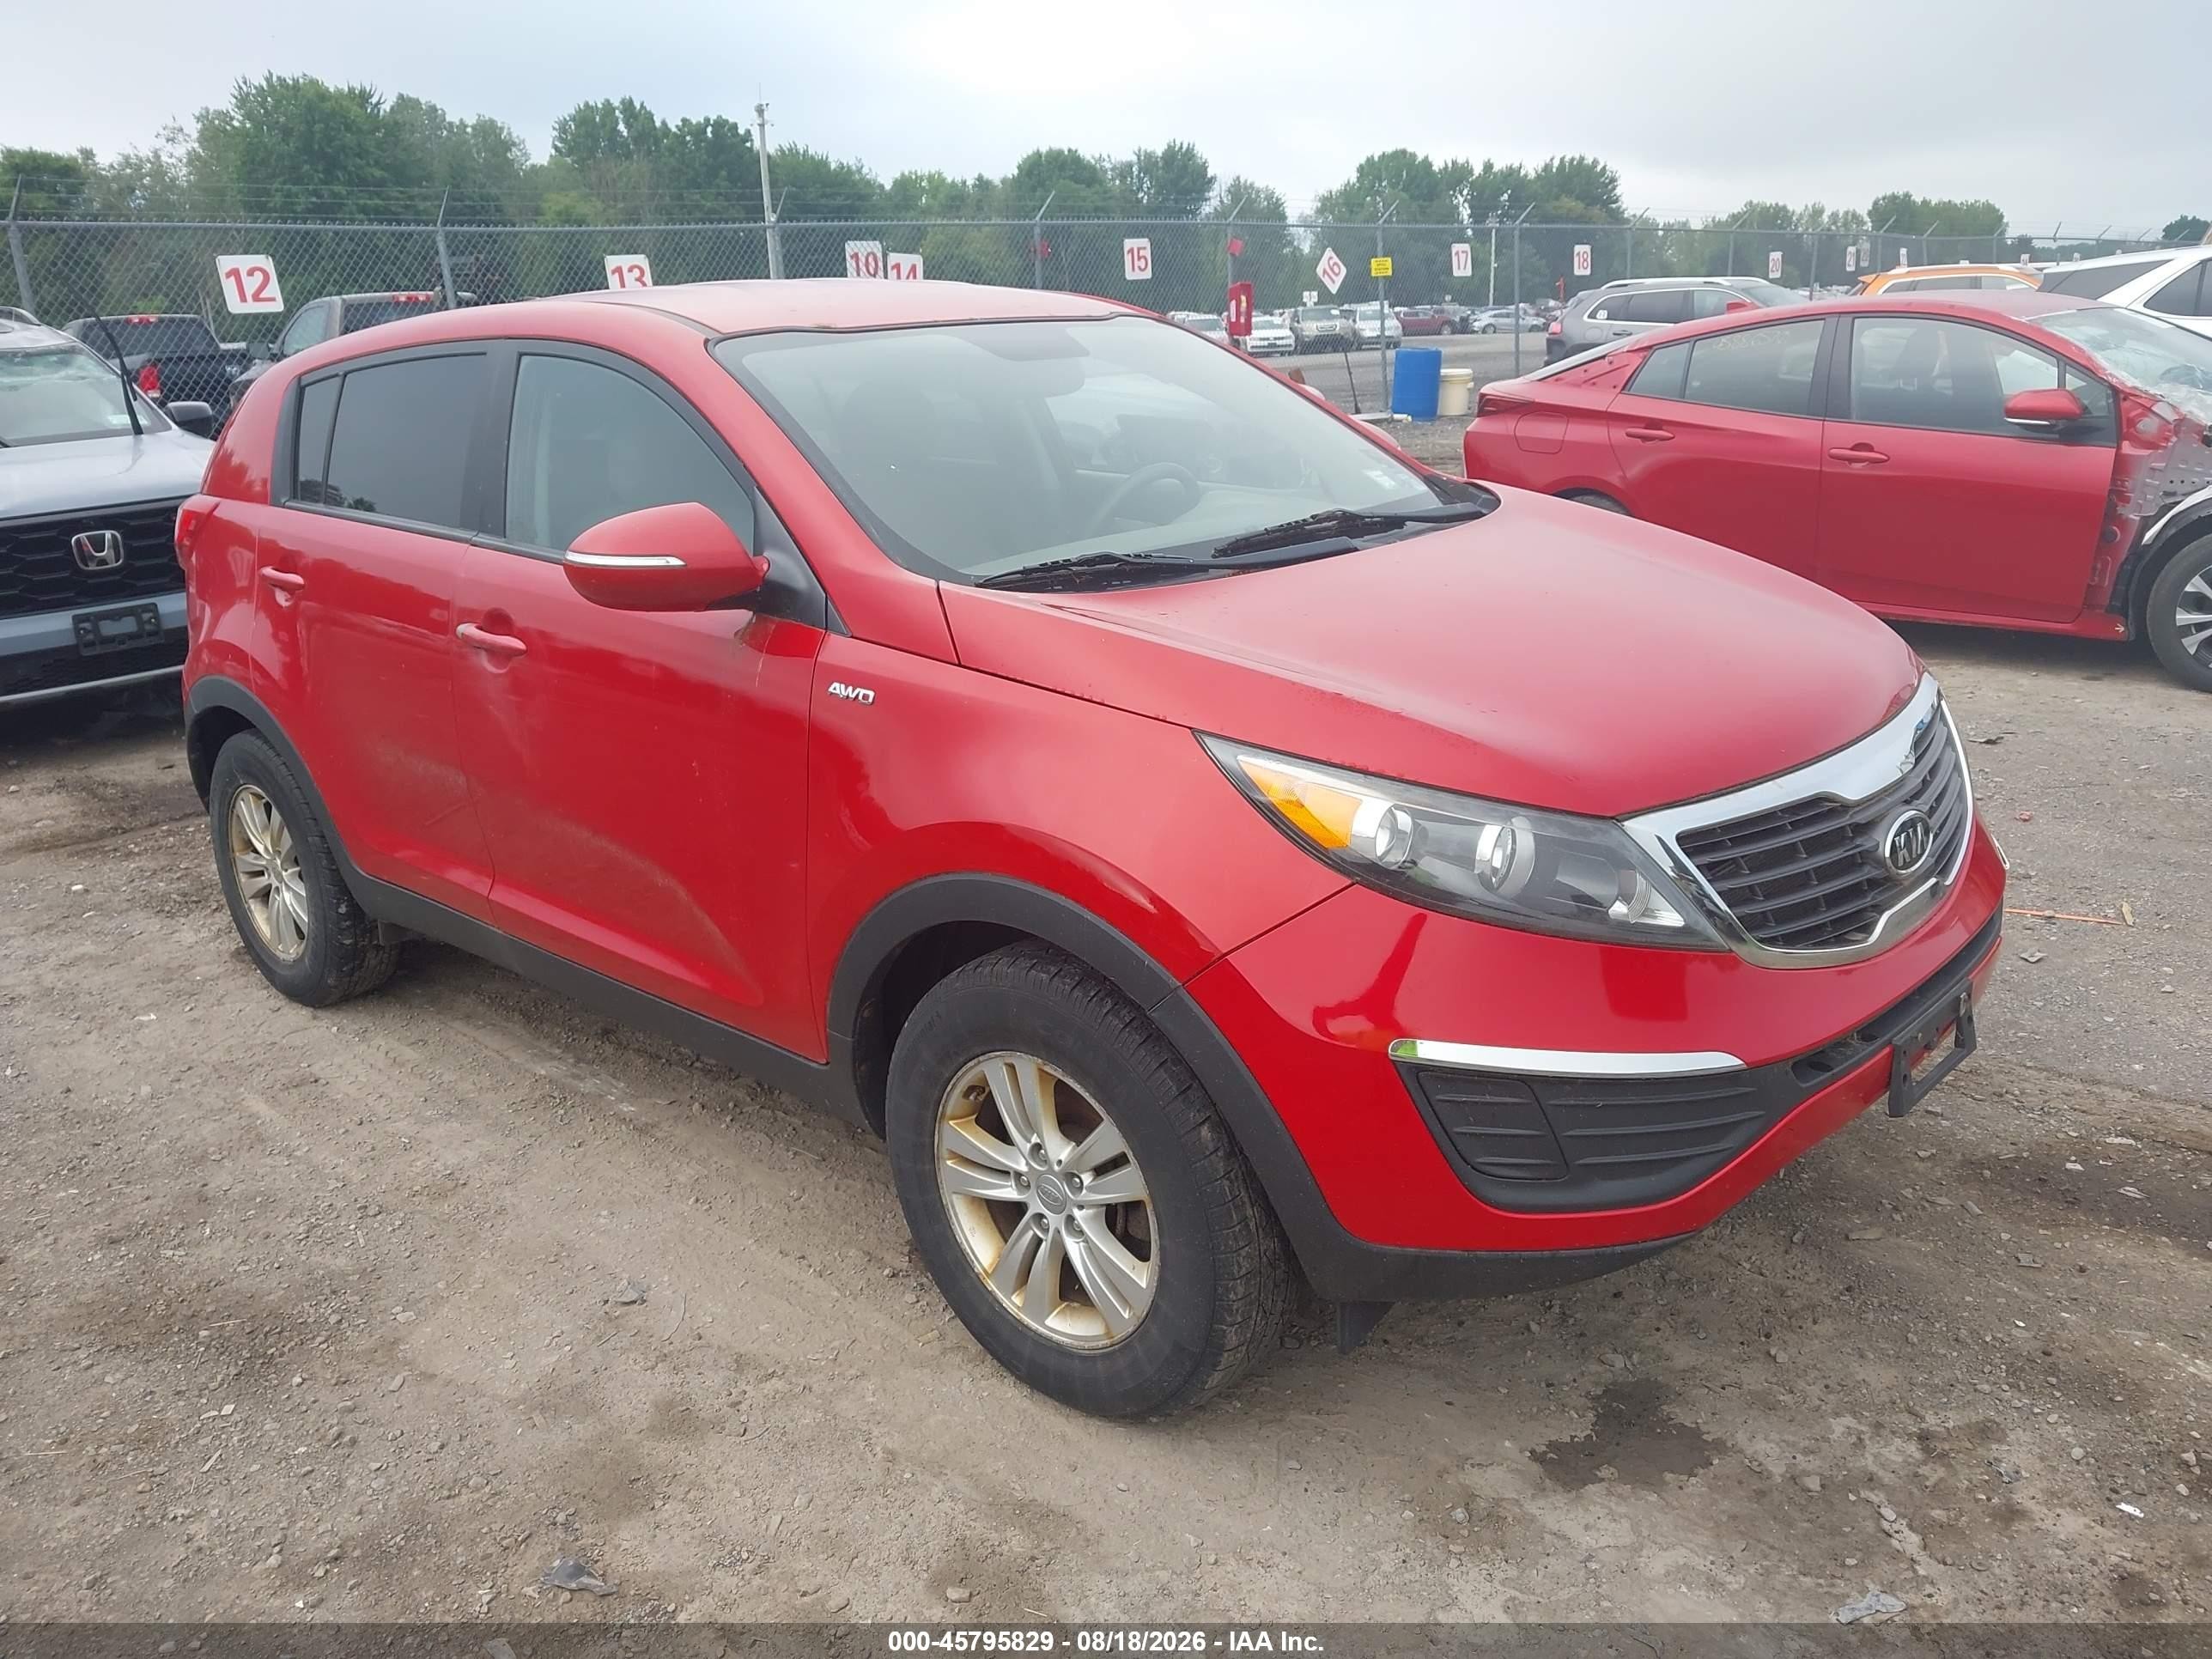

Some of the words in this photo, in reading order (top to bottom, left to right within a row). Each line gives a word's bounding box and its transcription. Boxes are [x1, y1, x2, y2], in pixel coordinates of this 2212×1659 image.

[850, 252, 878, 279] 10
[1127, 246, 1149, 272] 15
[1322, 257, 1341, 284] 16
[1455, 250, 1469, 270] 17
[1575, 251, 1589, 270] 18
[225, 266, 277, 303] 12
[611, 264, 647, 289] 13
[828, 682, 875, 704] AWD
